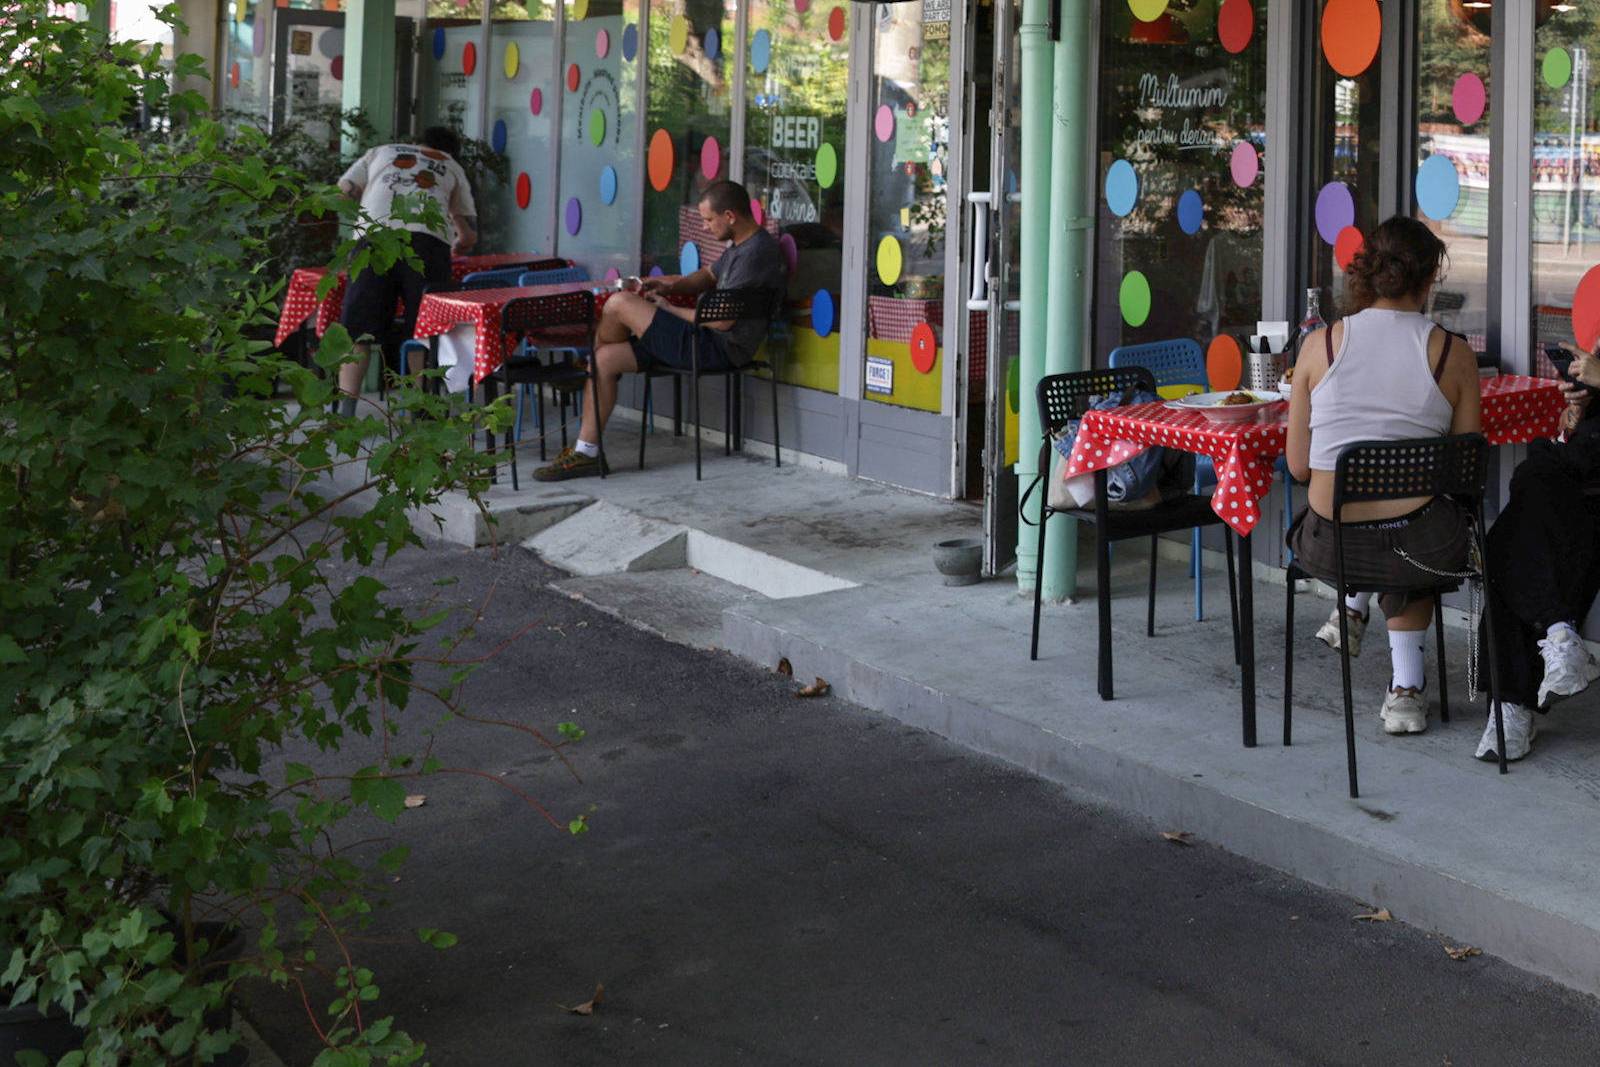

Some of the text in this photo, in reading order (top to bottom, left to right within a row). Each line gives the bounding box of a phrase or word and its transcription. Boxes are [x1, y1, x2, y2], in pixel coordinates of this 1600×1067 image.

[924, 10, 950, 22] PART OF
[925, 0, 936, 10] WE
[924, 23, 948, 36] FOMO
[772, 116, 819, 149] BEER
[1137, 120, 1178, 150] pentru
[771, 157, 817, 181] cocktails
[769, 187, 817, 222] & wine
